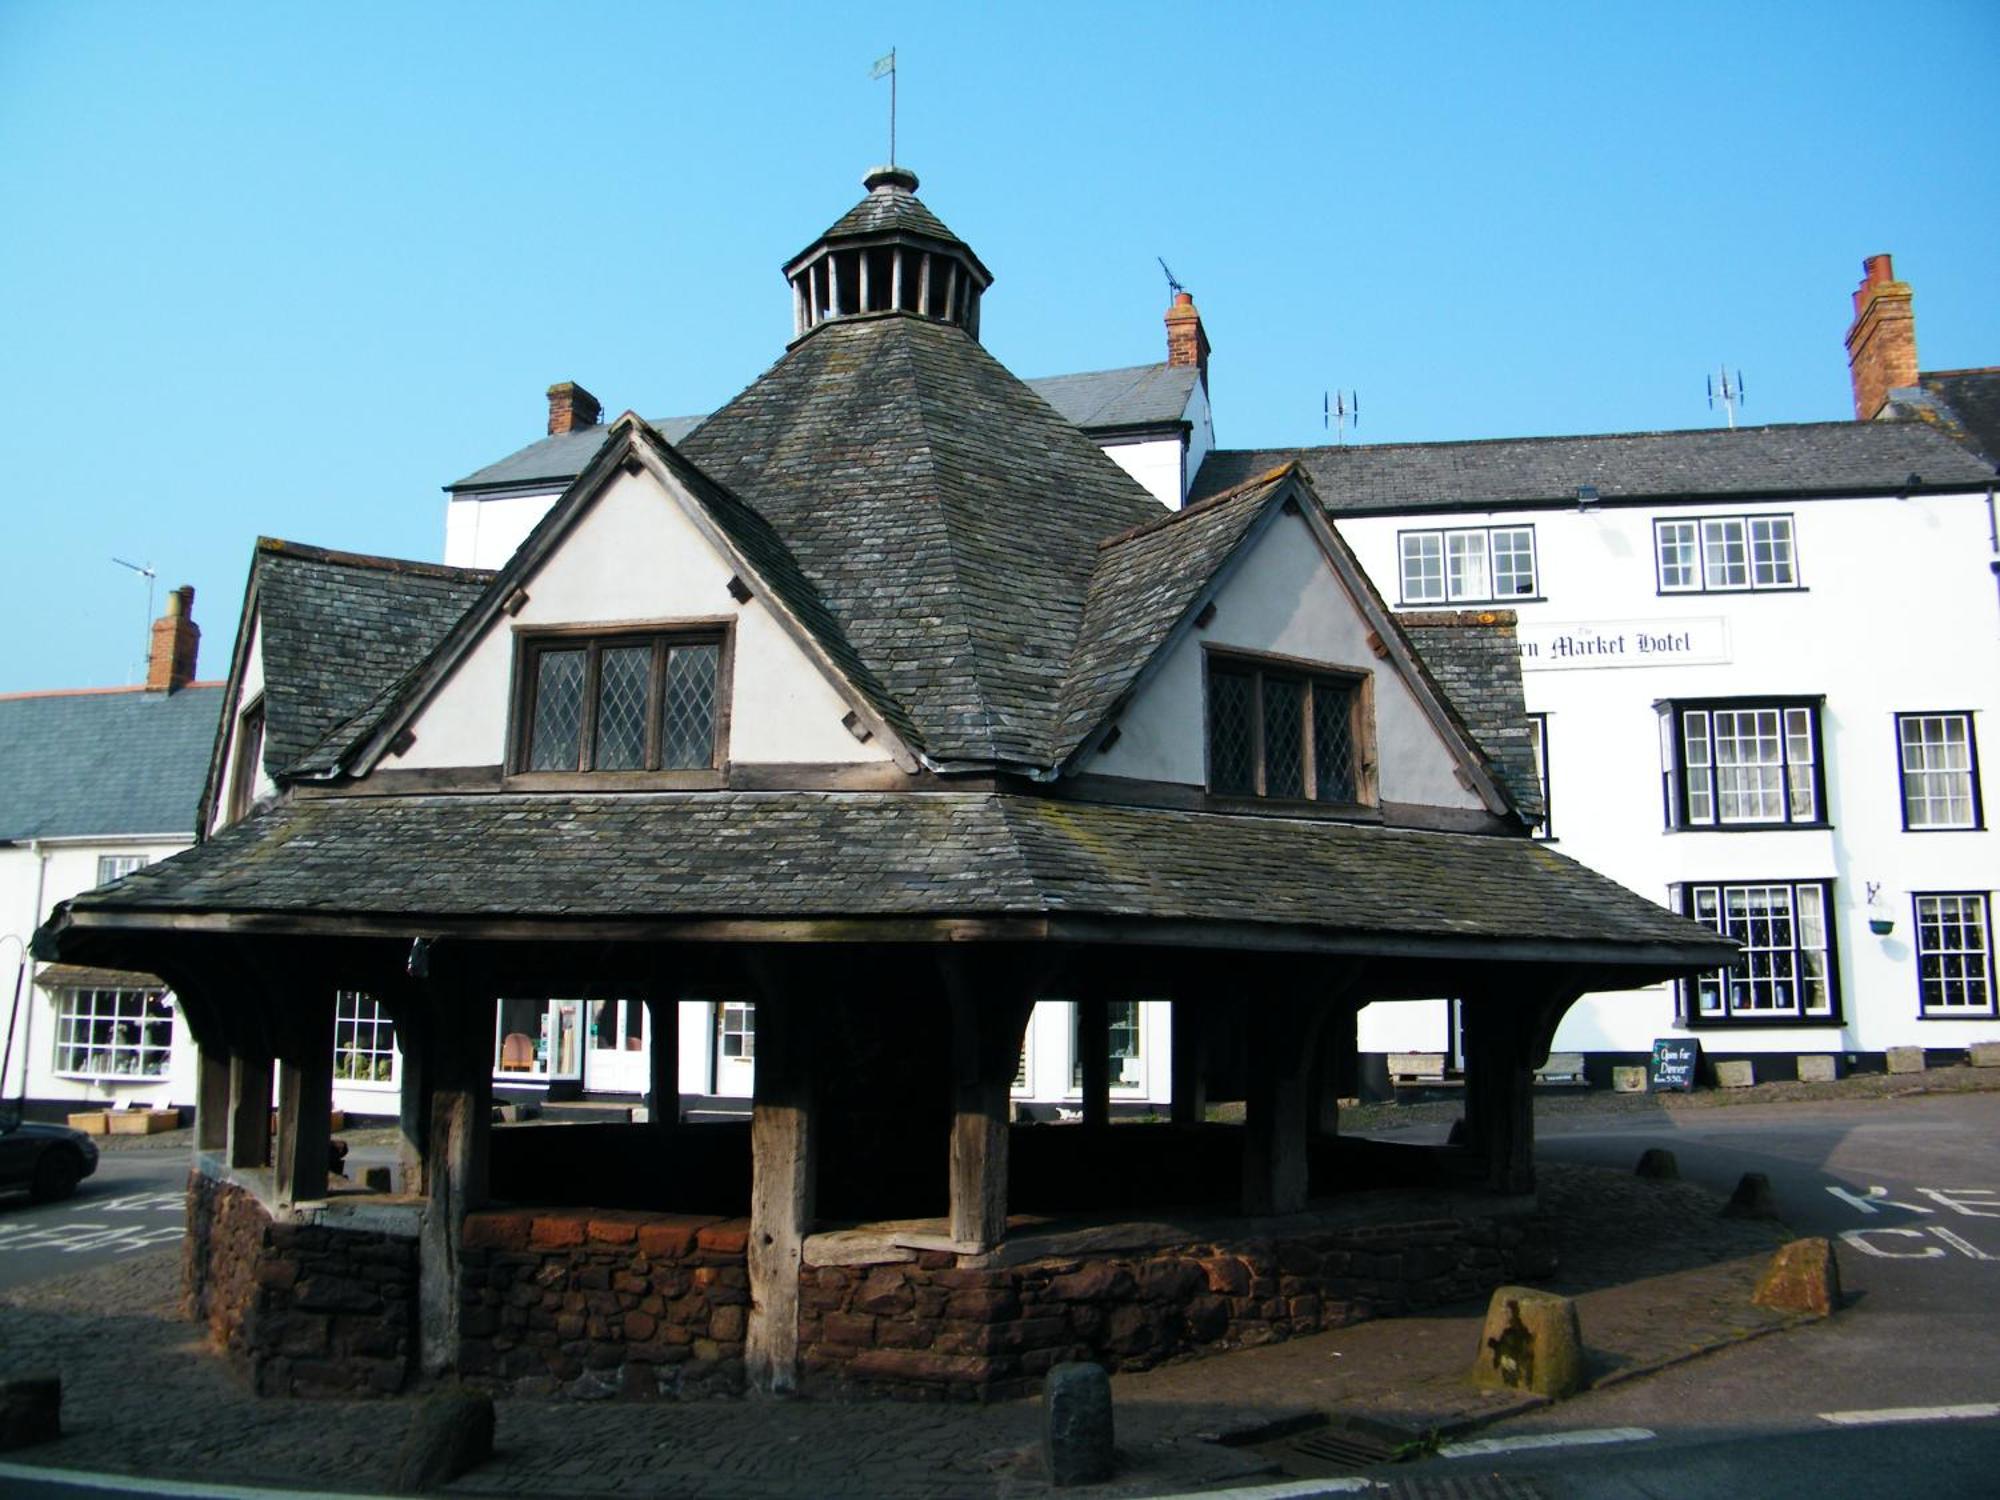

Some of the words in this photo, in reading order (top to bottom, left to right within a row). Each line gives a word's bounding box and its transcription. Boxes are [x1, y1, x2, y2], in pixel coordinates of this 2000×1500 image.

[1550, 635, 1625, 659] Market
[1636, 632, 1691, 653] Hotel
[1660, 1061, 1689, 1074] Dinner
